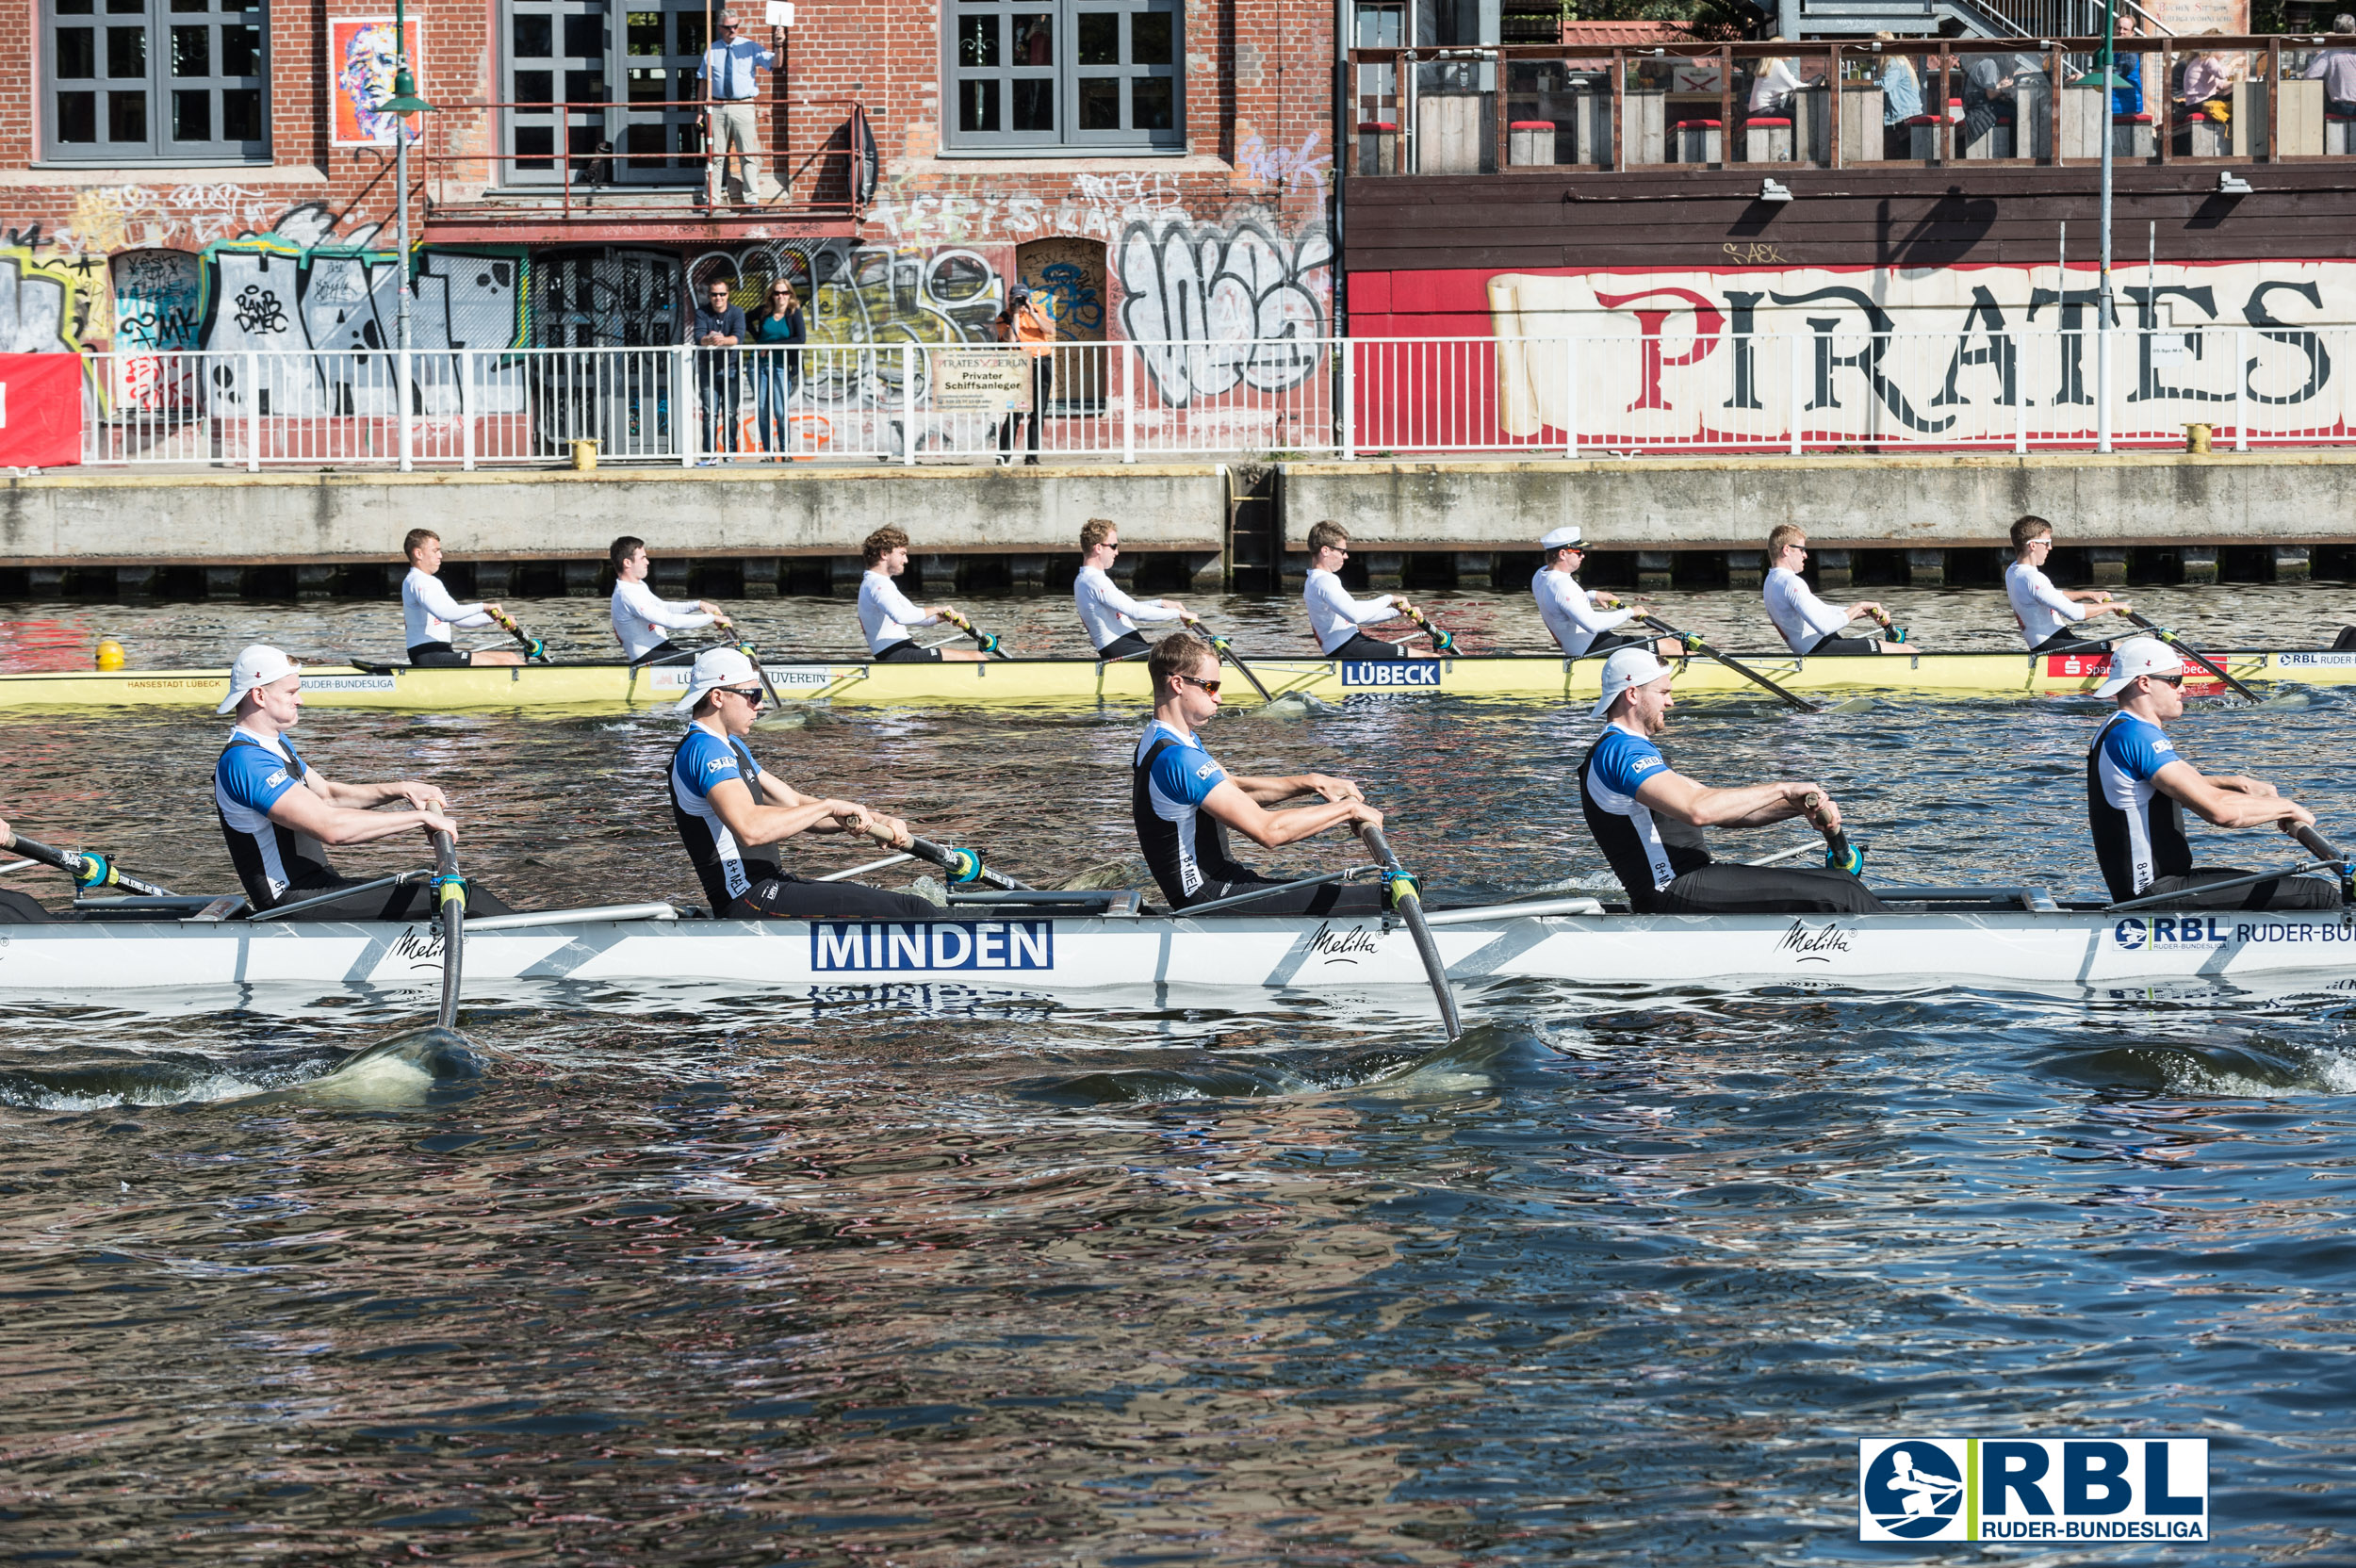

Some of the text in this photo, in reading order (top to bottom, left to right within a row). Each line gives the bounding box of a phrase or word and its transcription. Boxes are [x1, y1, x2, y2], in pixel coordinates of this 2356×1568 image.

[1594, 281, 2331, 433] PIRATES
[937, 358, 980, 368] PIRATES
[962, 371, 1003, 380] Privater
[945, 382, 1021, 391] Schiffsanleger
[2293, 655, 2317, 663] RBL
[1347, 662, 1436, 685] LÜBECK
[187, 678, 221, 688] LÜBECK
[301, 678, 394, 689] RUDER-BUNDESLIGA
[2153, 917, 2228, 942] RBL
[816, 923, 1048, 969] MINDEN
